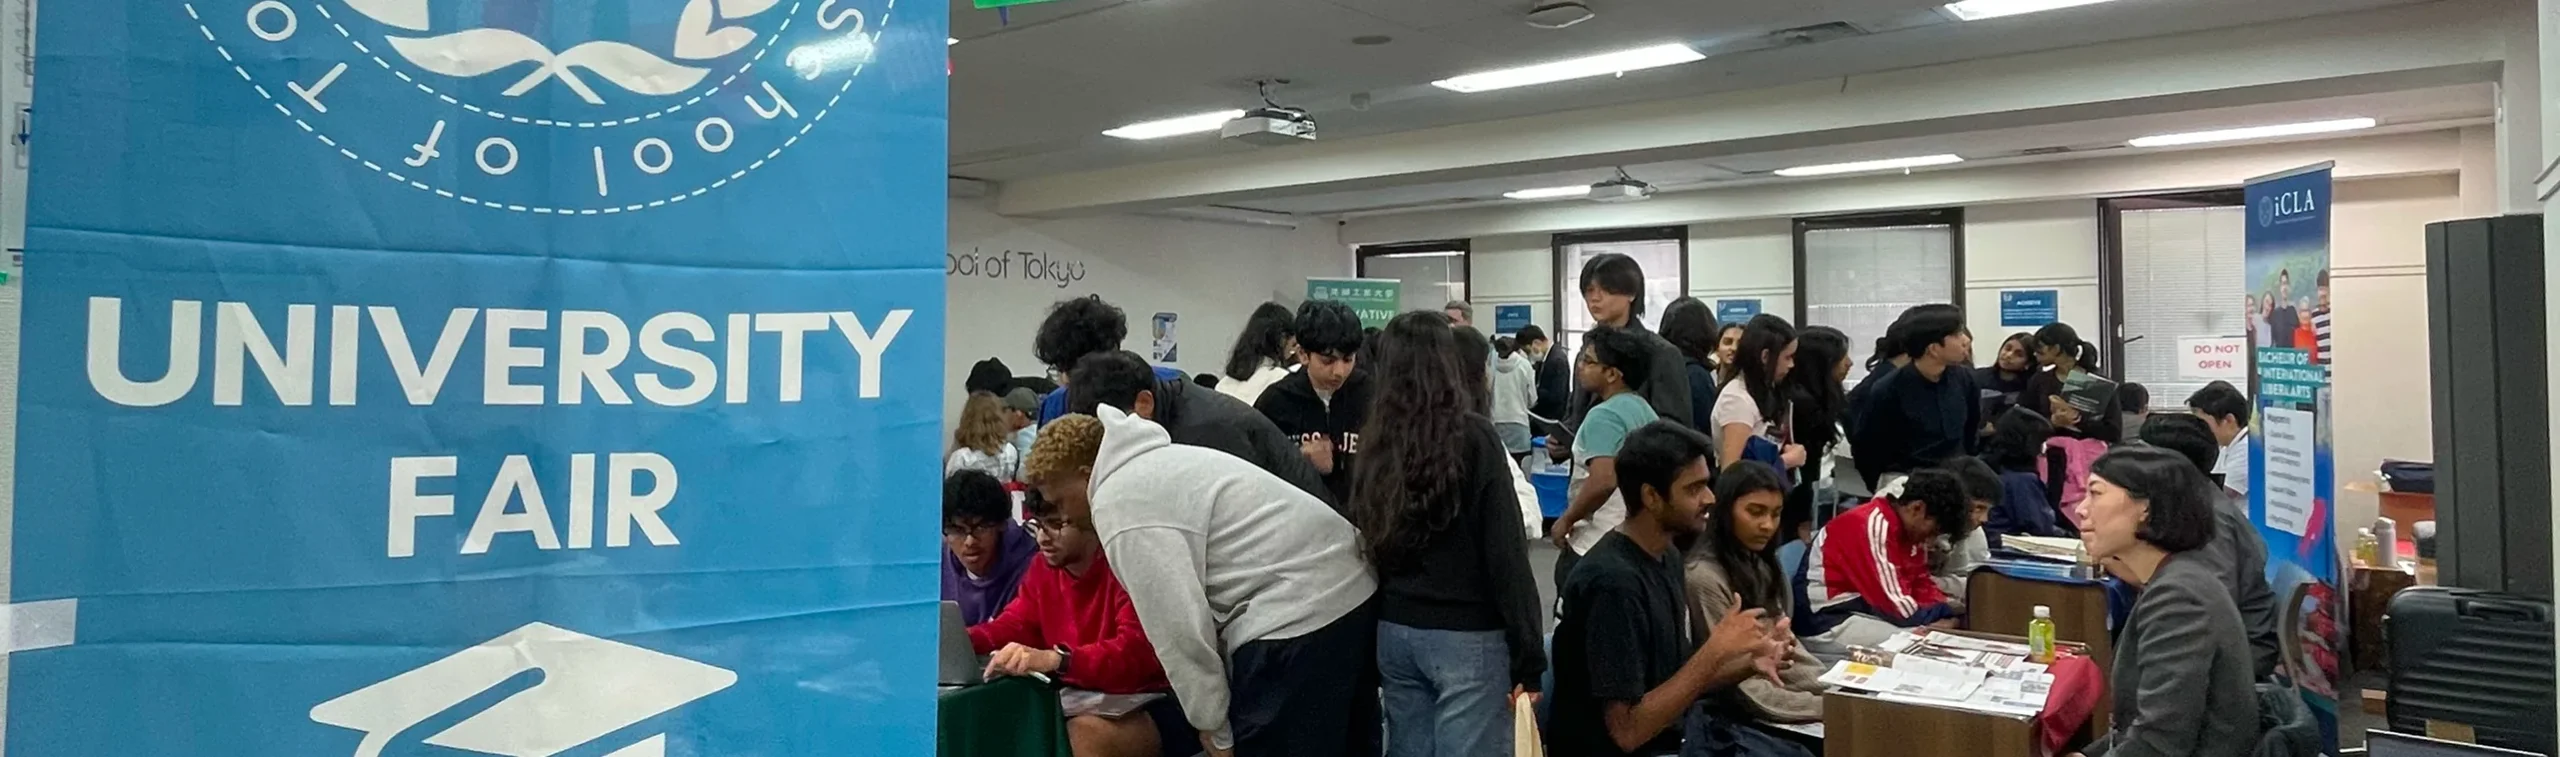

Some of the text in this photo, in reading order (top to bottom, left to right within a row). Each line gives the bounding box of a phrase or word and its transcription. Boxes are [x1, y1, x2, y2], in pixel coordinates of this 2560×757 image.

[404, 119, 519, 175] of
[2274, 189, 2315, 217] iCLA
[985, 250, 1011, 279] of
[1017, 251, 1086, 288] Tokyo
[87, 296, 914, 407] UNIVERSITY
[2194, 344, 2241, 354] DO NOT
[2198, 360, 2232, 369] OPEN
[2296, 352, 2309, 366] OF
[387, 452, 681, 558] FAIR
